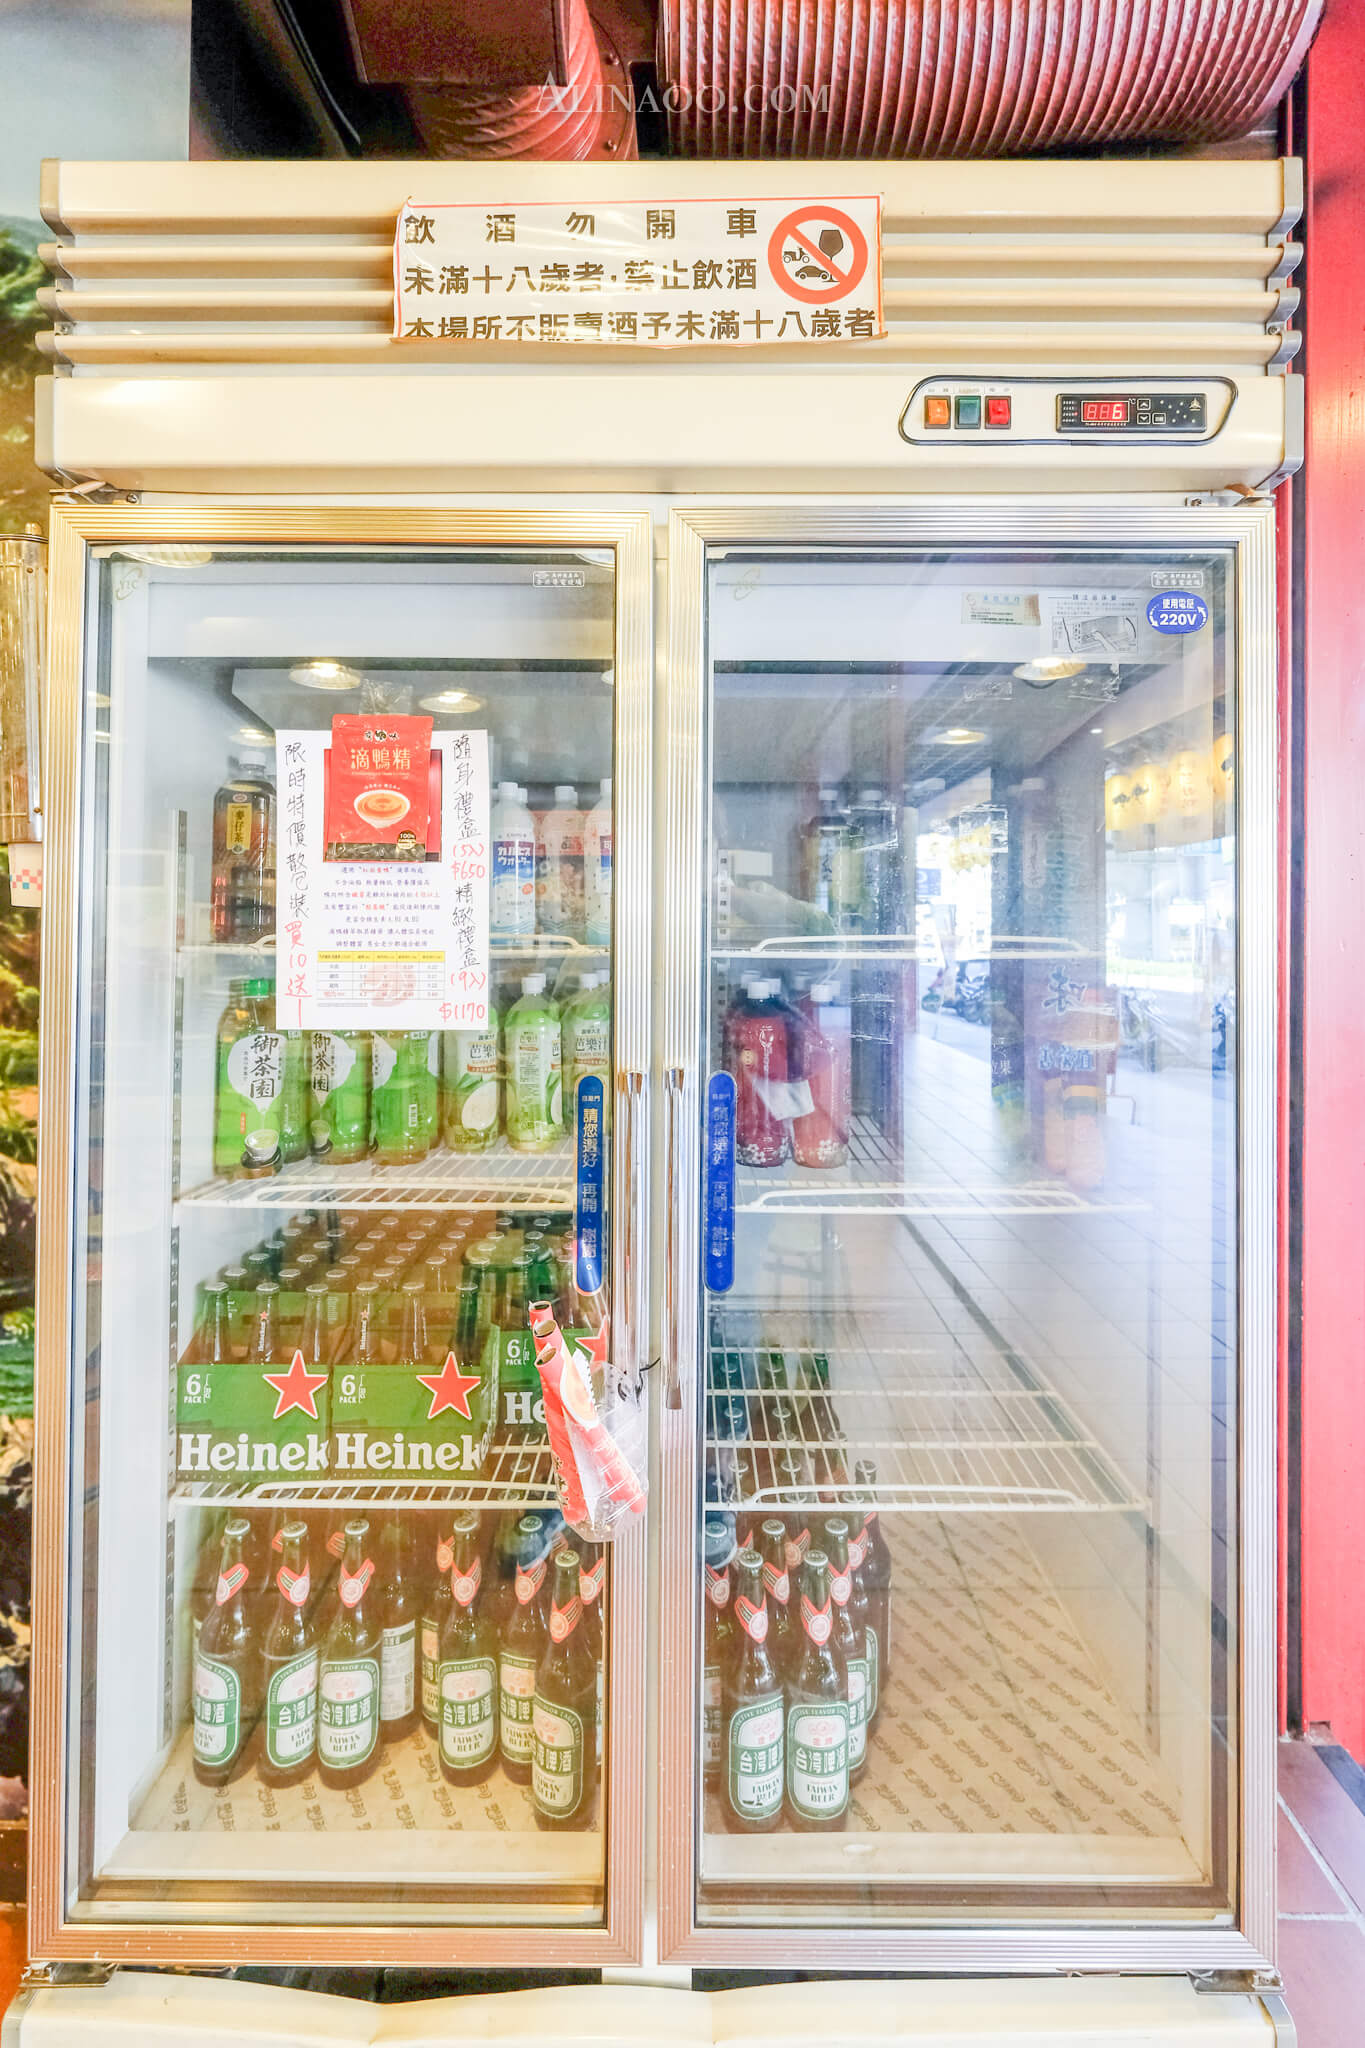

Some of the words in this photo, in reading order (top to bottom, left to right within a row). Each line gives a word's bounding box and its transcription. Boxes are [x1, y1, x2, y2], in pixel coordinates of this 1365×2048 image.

[1162, 598, 1195, 609] 使用電壓
[1159, 613, 1198, 626] 220V
[350, 747, 411, 770] 滴鴨精
[450, 861, 486, 880] $650
[438, 1002, 486, 1023] $1170
[249, 1034, 279, 1099] 御茶園
[312, 1032, 331, 1092] 御茶園
[507, 1339, 521, 1358] 6
[505, 1358, 523, 1366] PACK
[186, 1374, 201, 1396] 6
[341, 1374, 356, 1395] 6
[183, 1396, 202, 1404] PACK
[339, 1396, 357, 1404] PACK
[321, 1696, 371, 1726] 台灣啤酒
[443, 1694, 492, 1725] 台灣啤酒
[329, 1733, 360, 1744] TAIWAN
[453, 1731, 484, 1744] TAIWAN
[332, 1742, 357, 1753] BEER
[456, 1742, 481, 1753] BEER
[795, 1744, 846, 1774] 台灣啤酒
[807, 1782, 839, 1793] TAIWAN
[810, 1792, 836, 1804] BEER
